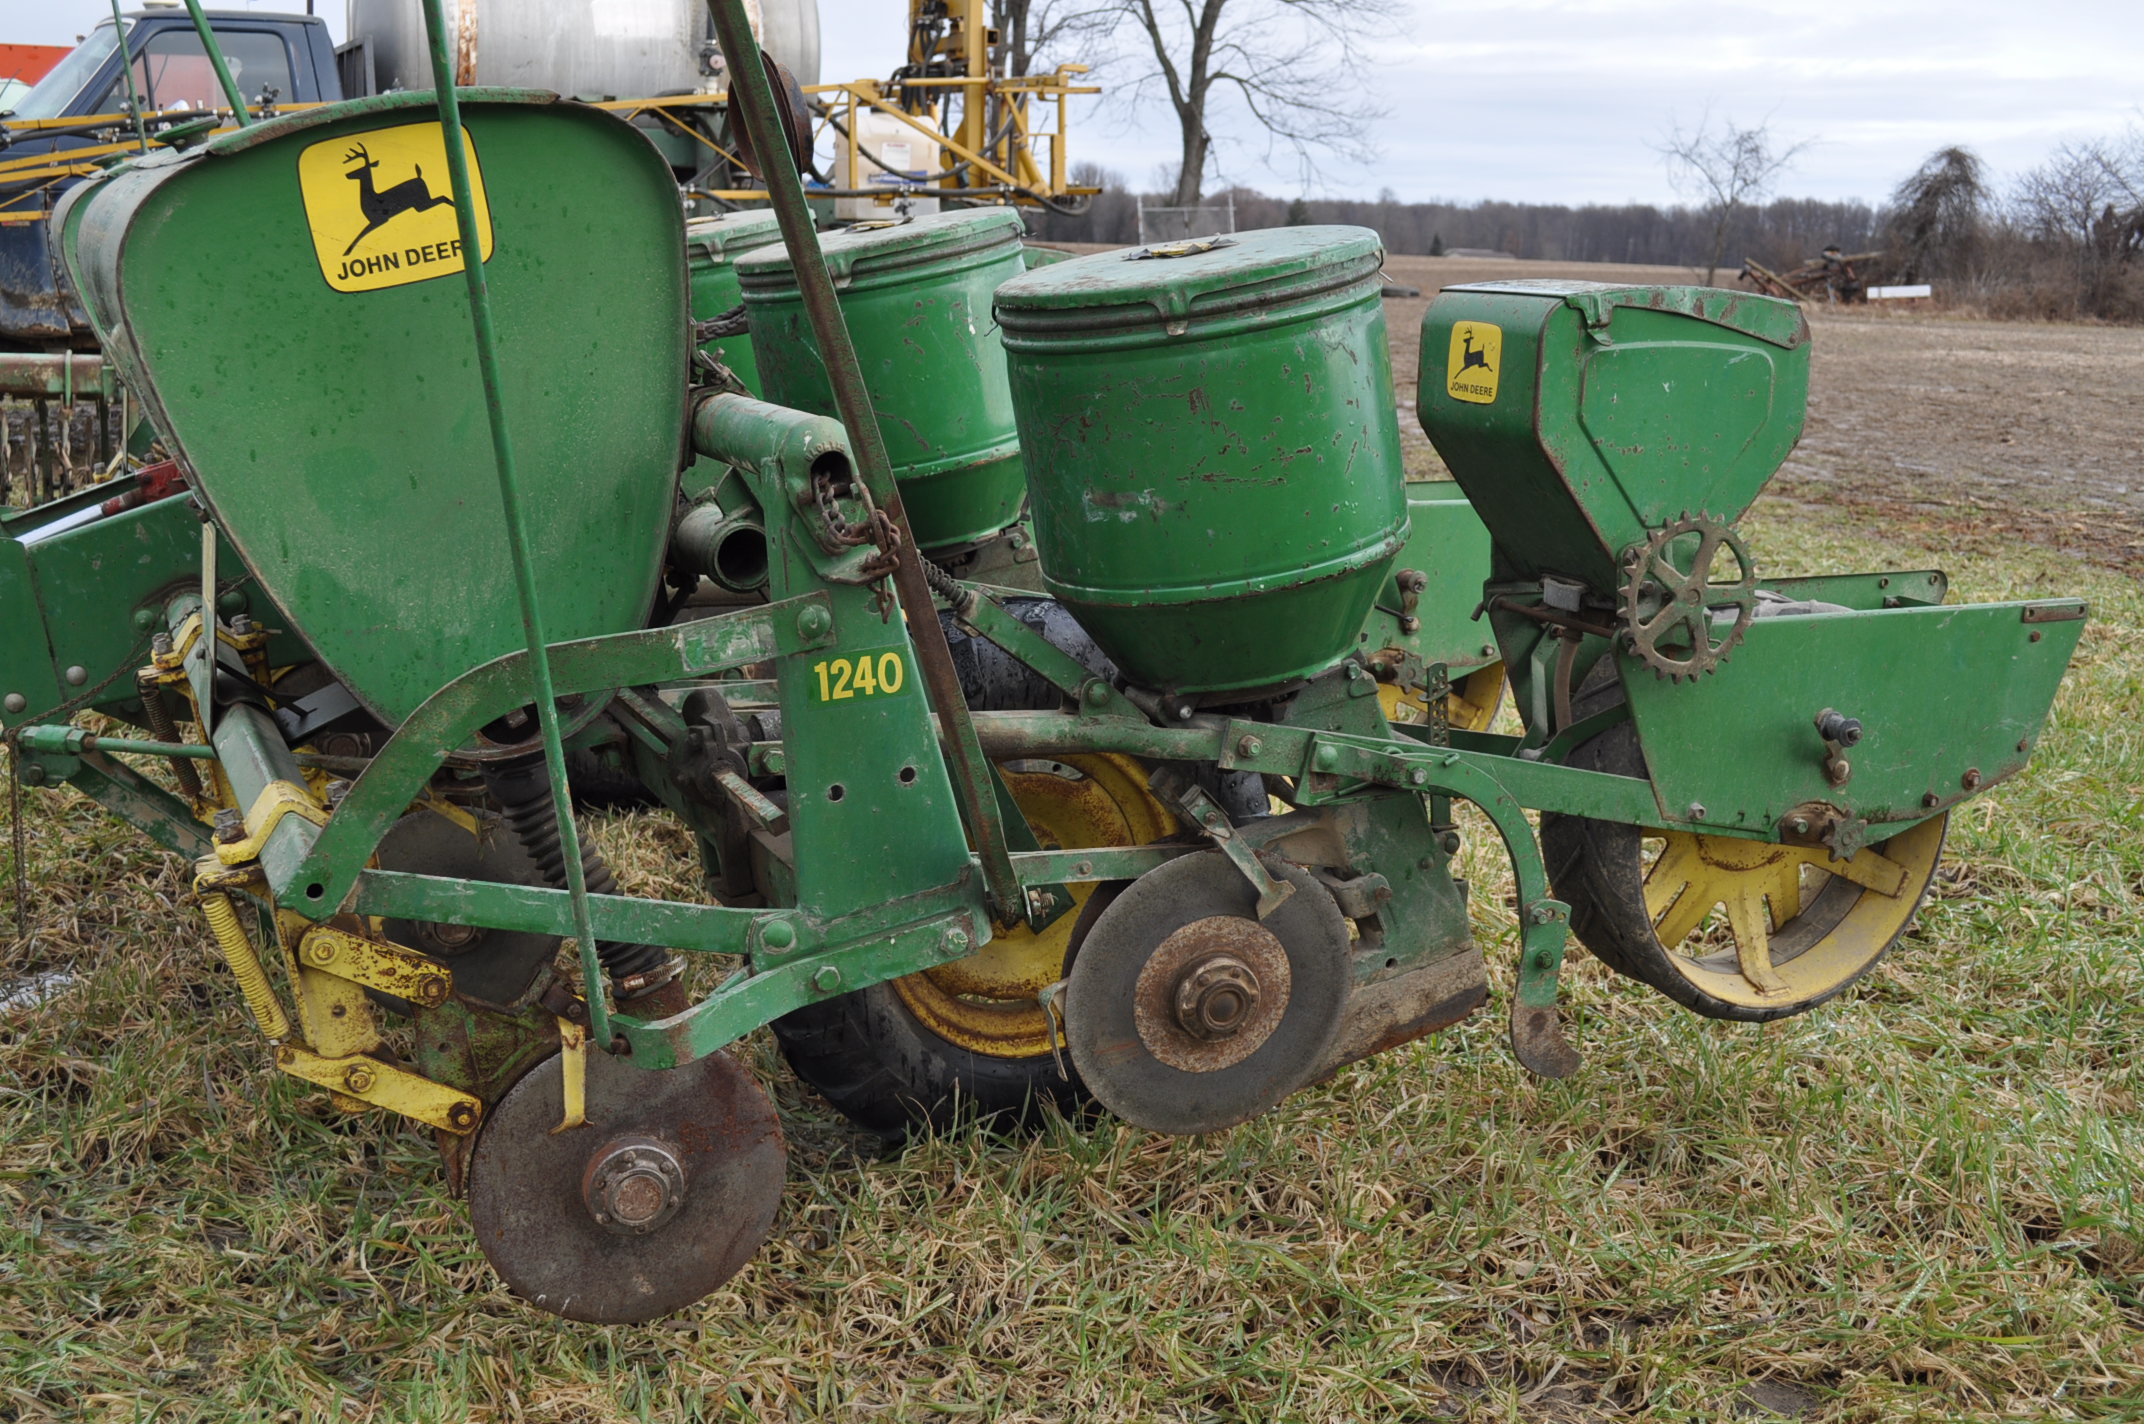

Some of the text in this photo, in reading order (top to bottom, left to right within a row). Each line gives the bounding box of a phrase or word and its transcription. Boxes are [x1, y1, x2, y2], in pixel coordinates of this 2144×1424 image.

[337, 239, 464, 280] JOHN DEER
[1451, 381, 1493, 397] JOHN DEERE
[814, 652, 903, 701] 1240
